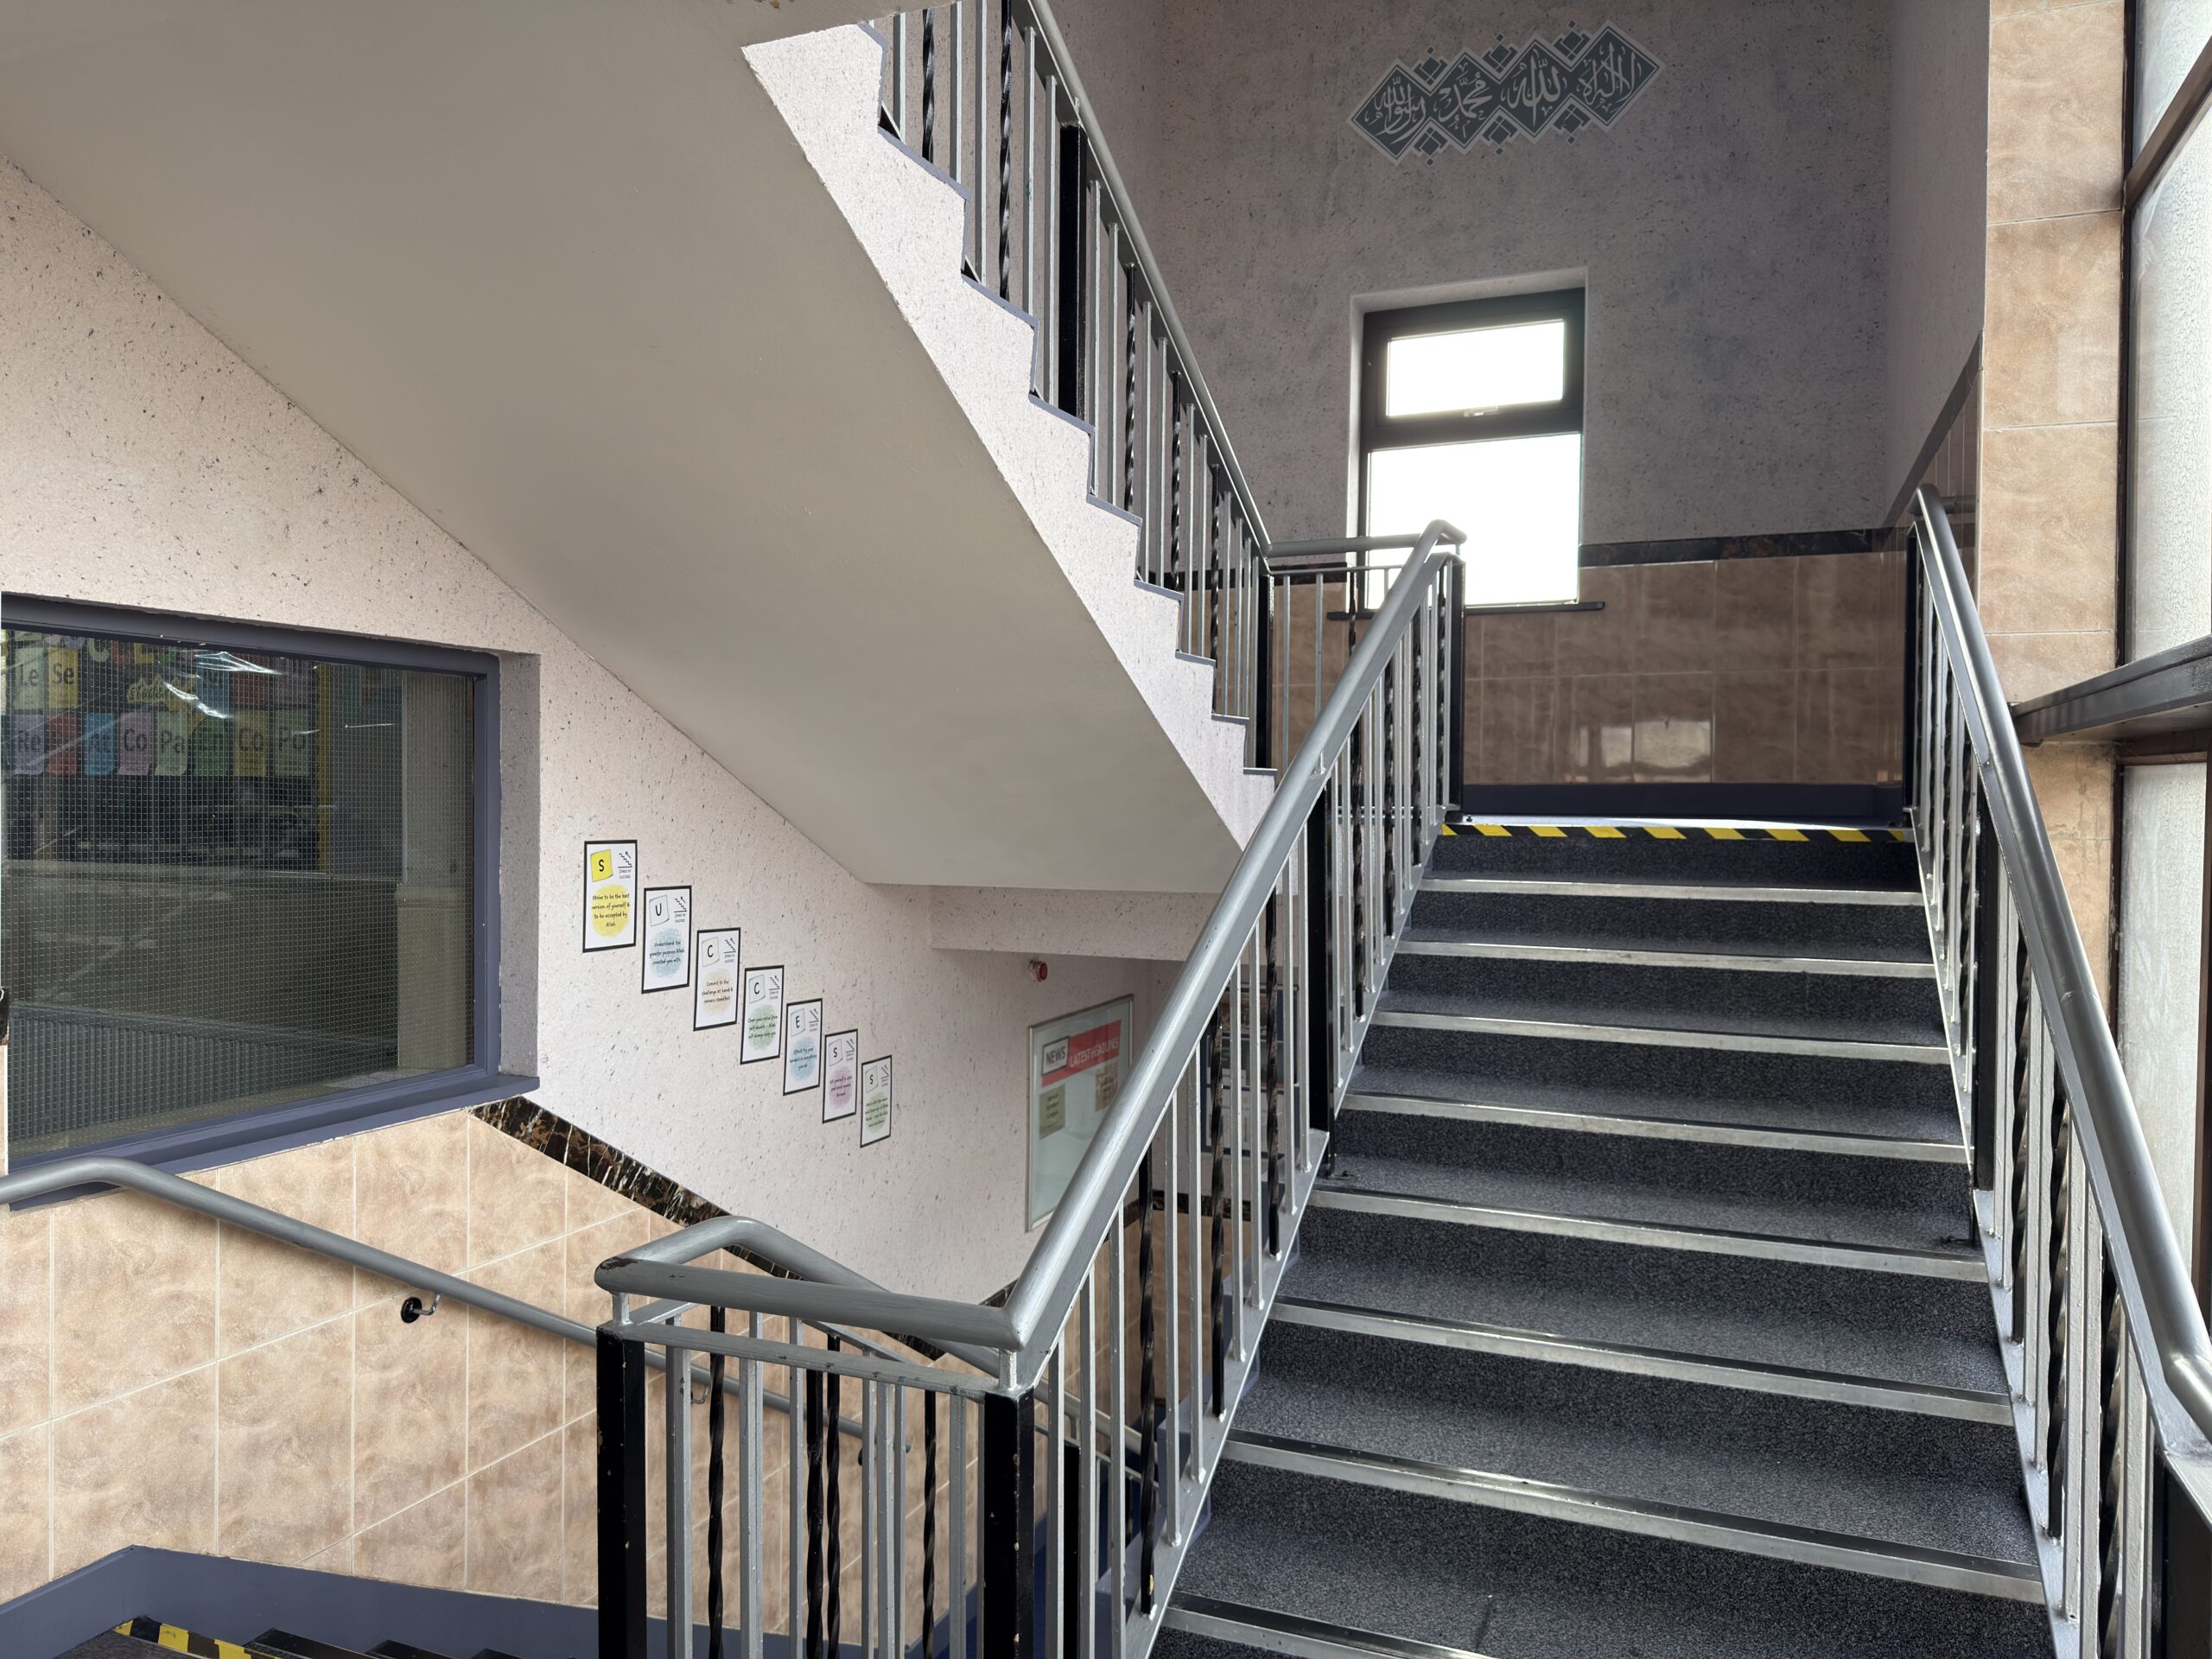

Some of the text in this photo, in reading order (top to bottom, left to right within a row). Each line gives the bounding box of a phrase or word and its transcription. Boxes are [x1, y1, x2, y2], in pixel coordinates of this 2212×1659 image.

[54, 664, 75, 685] Se
[124, 729, 148, 752] Co
[162, 731, 186, 754] Pa
[598, 859, 605, 872] S
[611, 902, 626, 911] yourself
[656, 903, 662, 917] U
[707, 944, 714, 957] C
[753, 982, 760, 995] C
[796, 1015, 800, 1028] E
[833, 1047, 837, 1058] S
[1046, 1046, 1066, 1065] NEWS
[1070, 1037, 1120, 1067] LATEST HEADLINES
[869, 1074, 874, 1084] S
